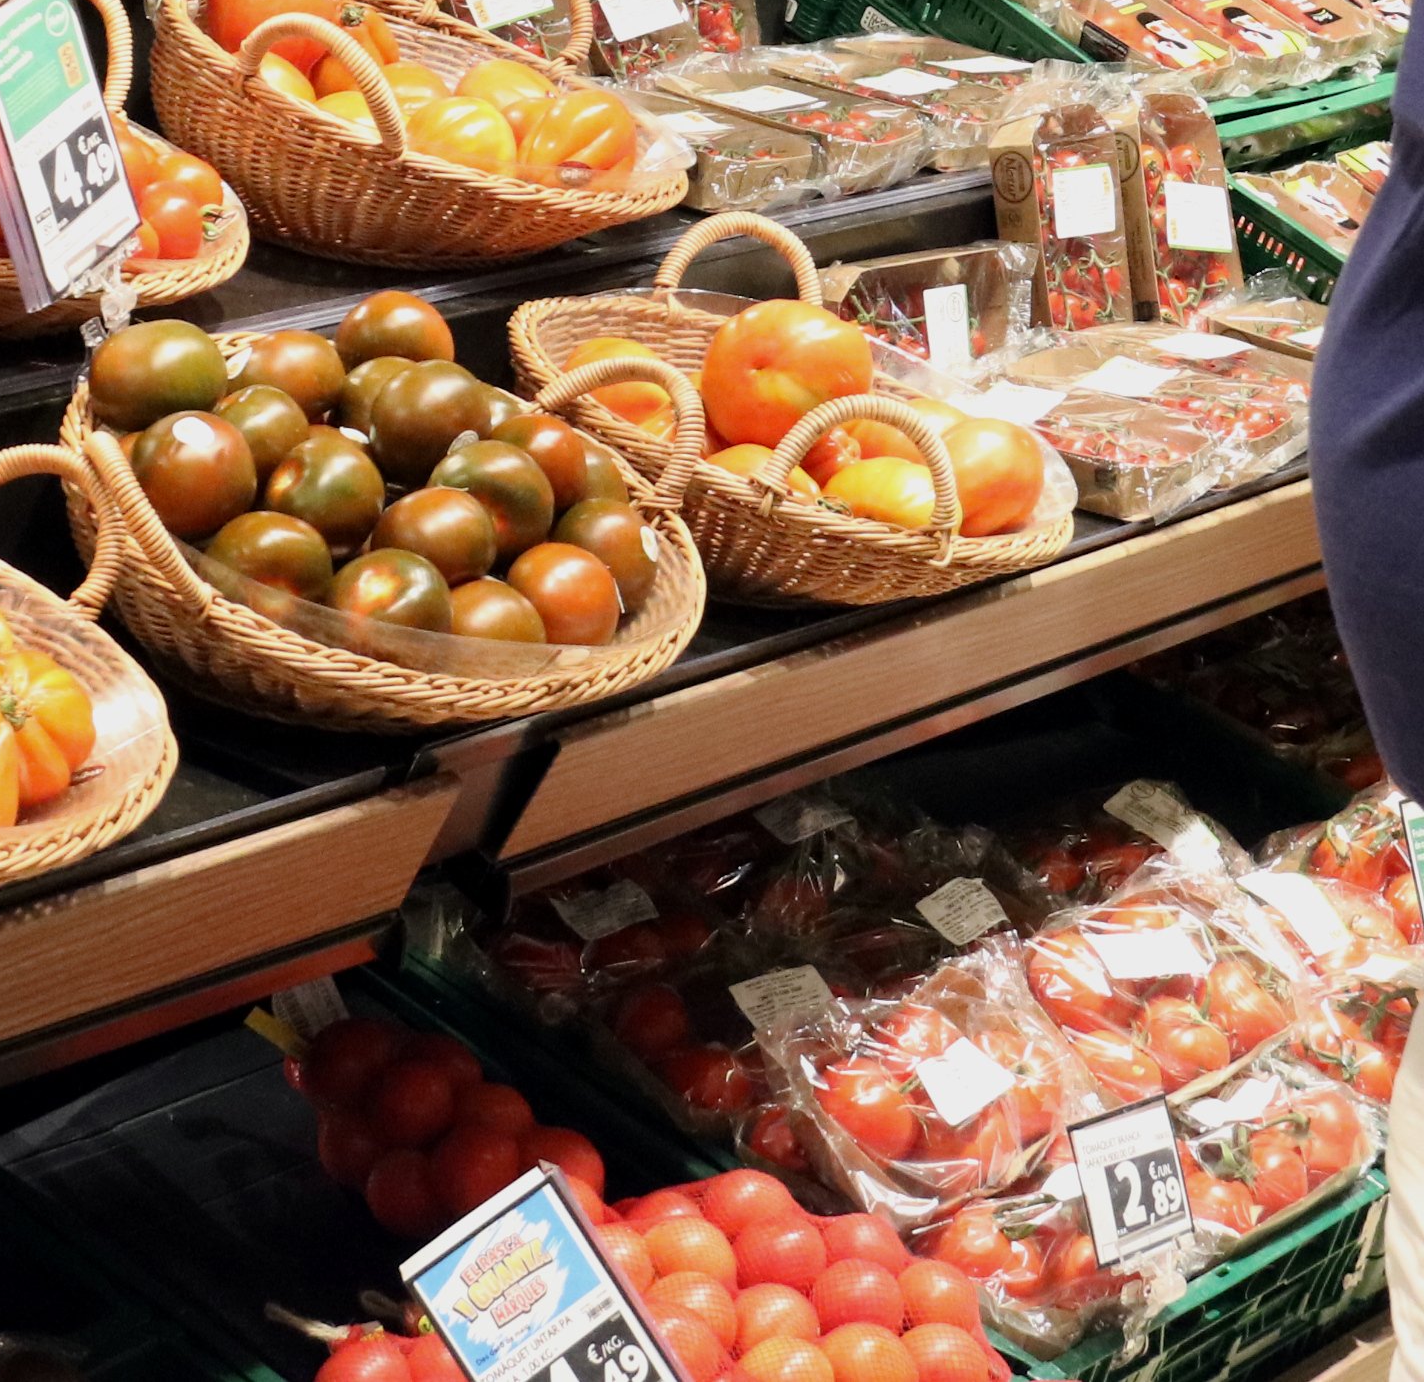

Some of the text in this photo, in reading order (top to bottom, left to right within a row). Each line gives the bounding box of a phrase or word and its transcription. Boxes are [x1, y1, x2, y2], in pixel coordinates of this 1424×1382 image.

[53, 140, 117, 210] 4,49
[1114, 1160, 1183, 1227] 2,89
[461, 1266, 481, 1286] EL
[490, 1275, 548, 1330] MARQUES
[530, 1328, 559, 1353] UNTAR
